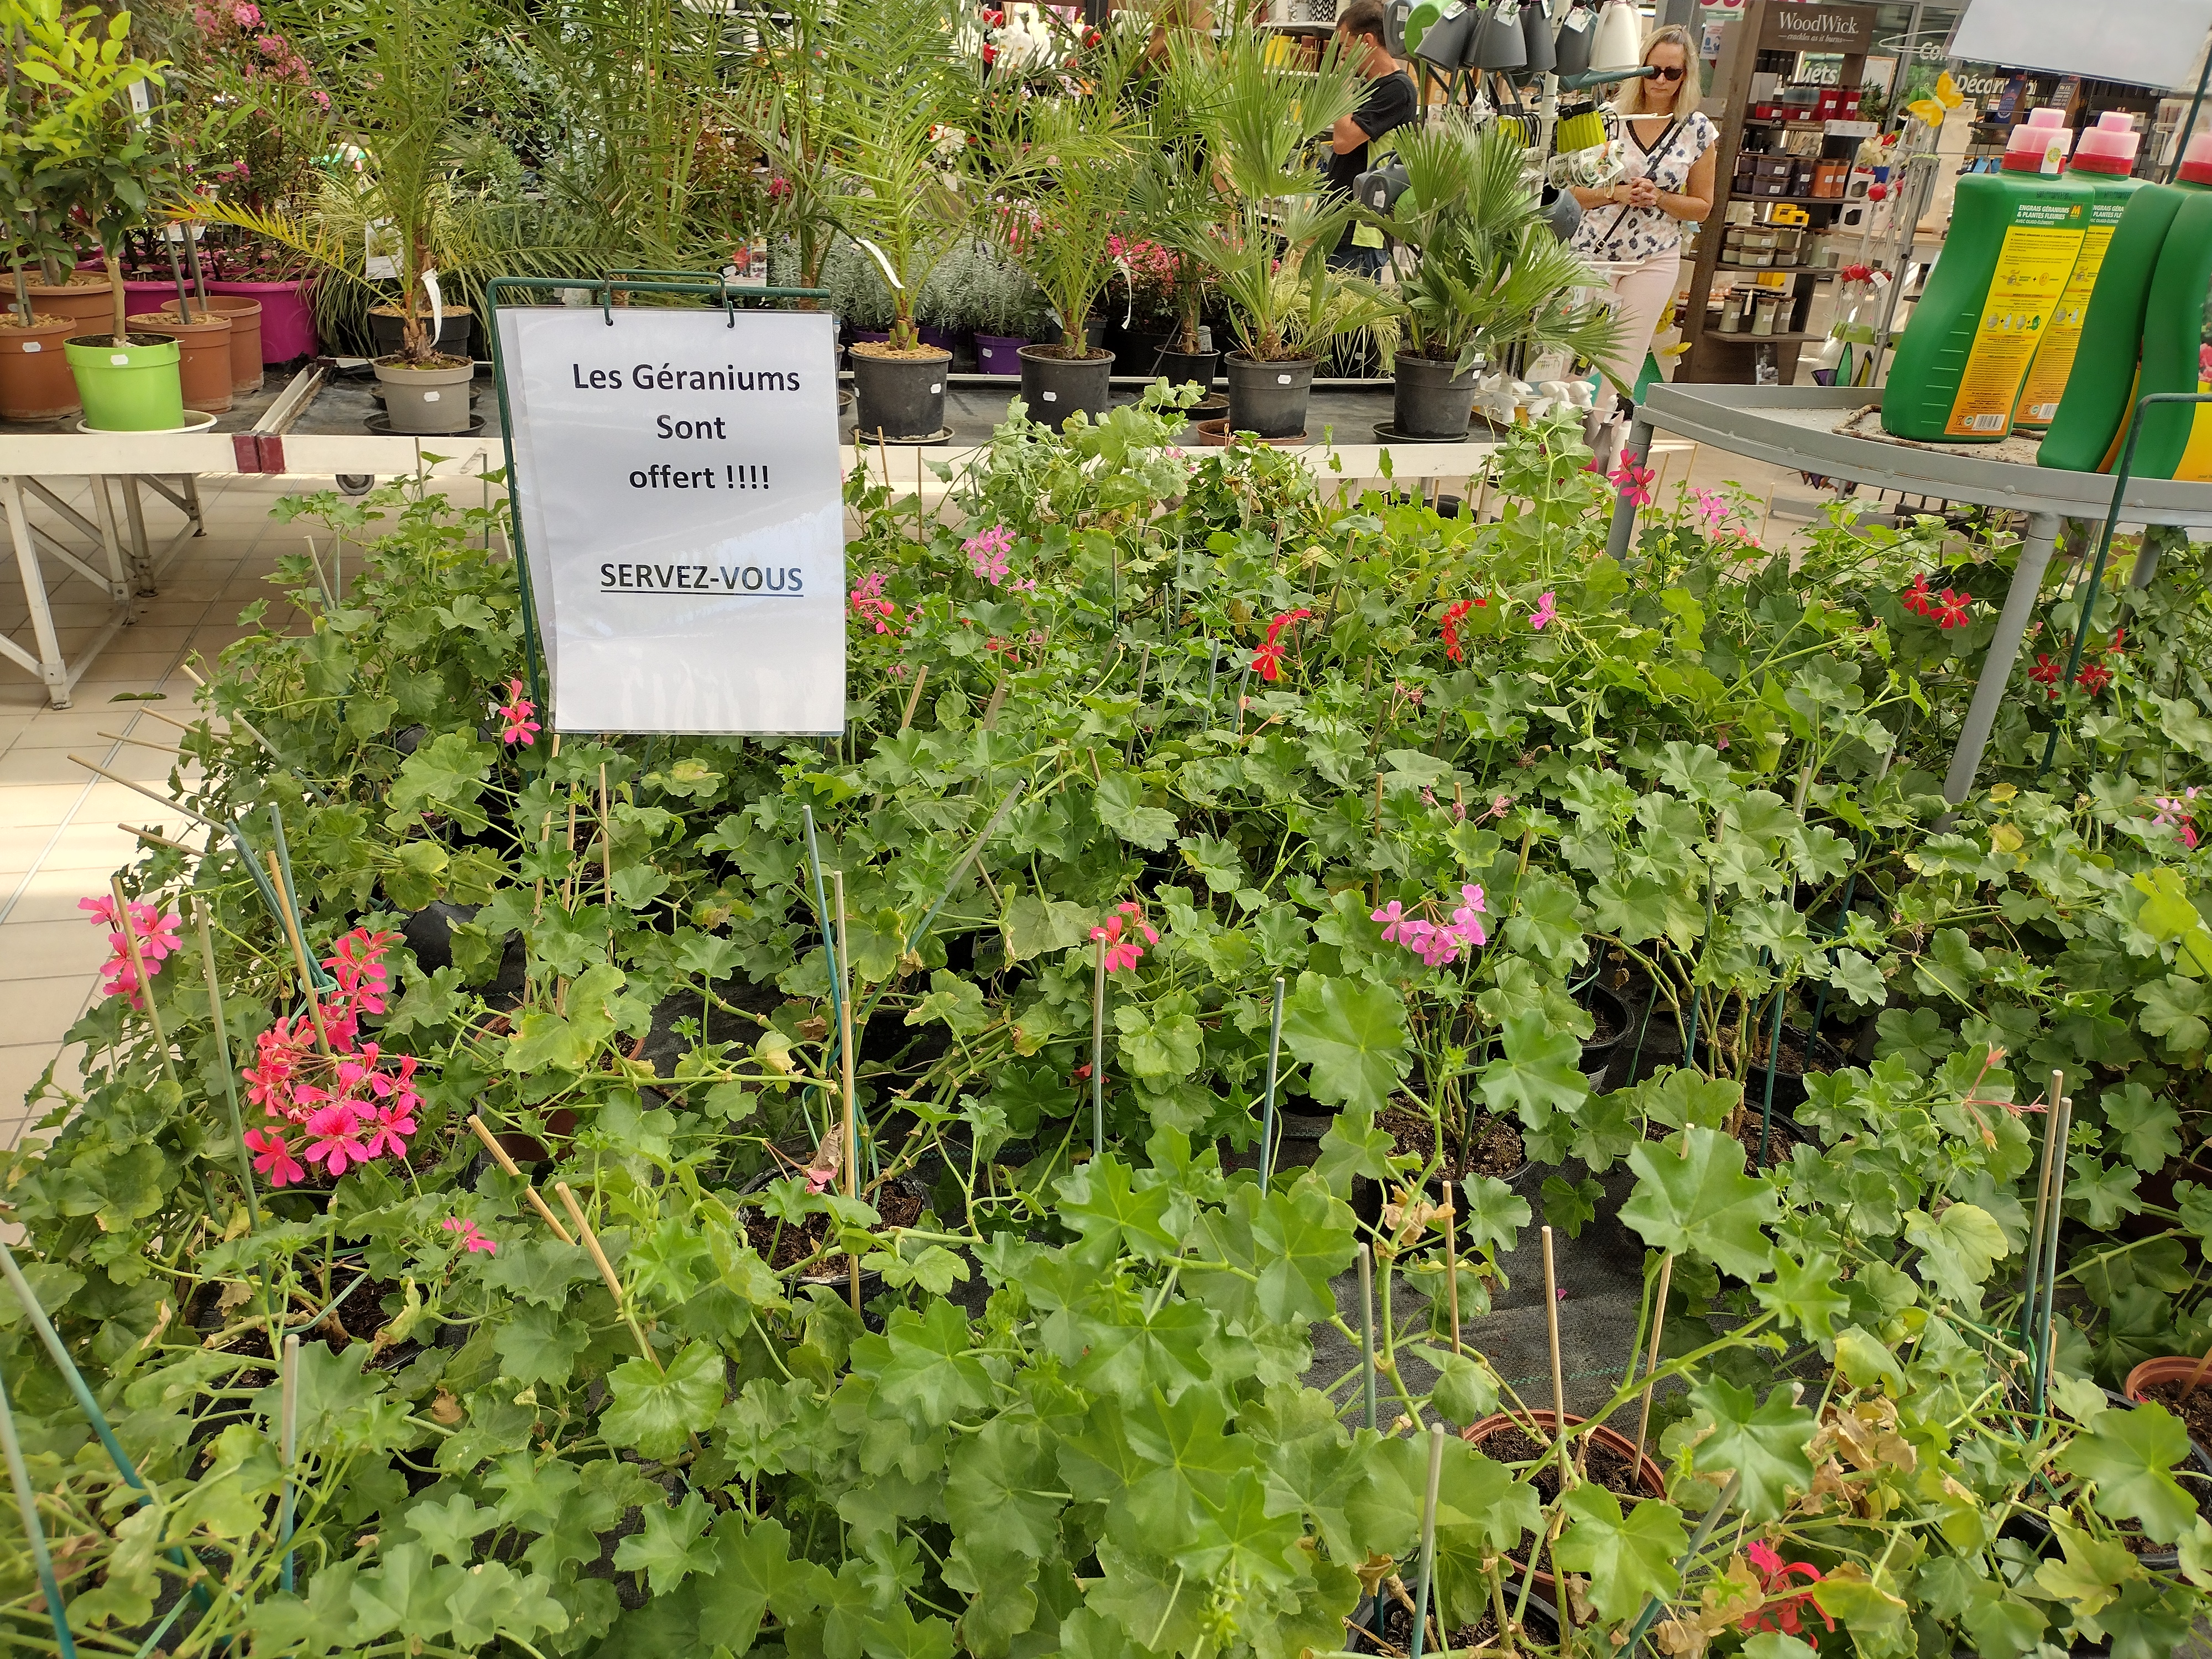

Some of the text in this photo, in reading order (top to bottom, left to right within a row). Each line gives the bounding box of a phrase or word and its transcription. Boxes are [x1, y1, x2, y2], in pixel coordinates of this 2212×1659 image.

[1779, 11, 1857, 34] WoodWick
[1787, 33, 1809, 41] crackles
[1825, 35, 1843, 43] burns
[1799, 65, 1838, 85] uets
[2042, 205, 2070, 213] GÉRANIUMS
[573, 363, 801, 392] Les Géraniums
[656, 414, 727, 440] Sont
[629, 464, 770, 489] offert !!!!
[600, 563, 804, 592] SERVEZ-VOUS
